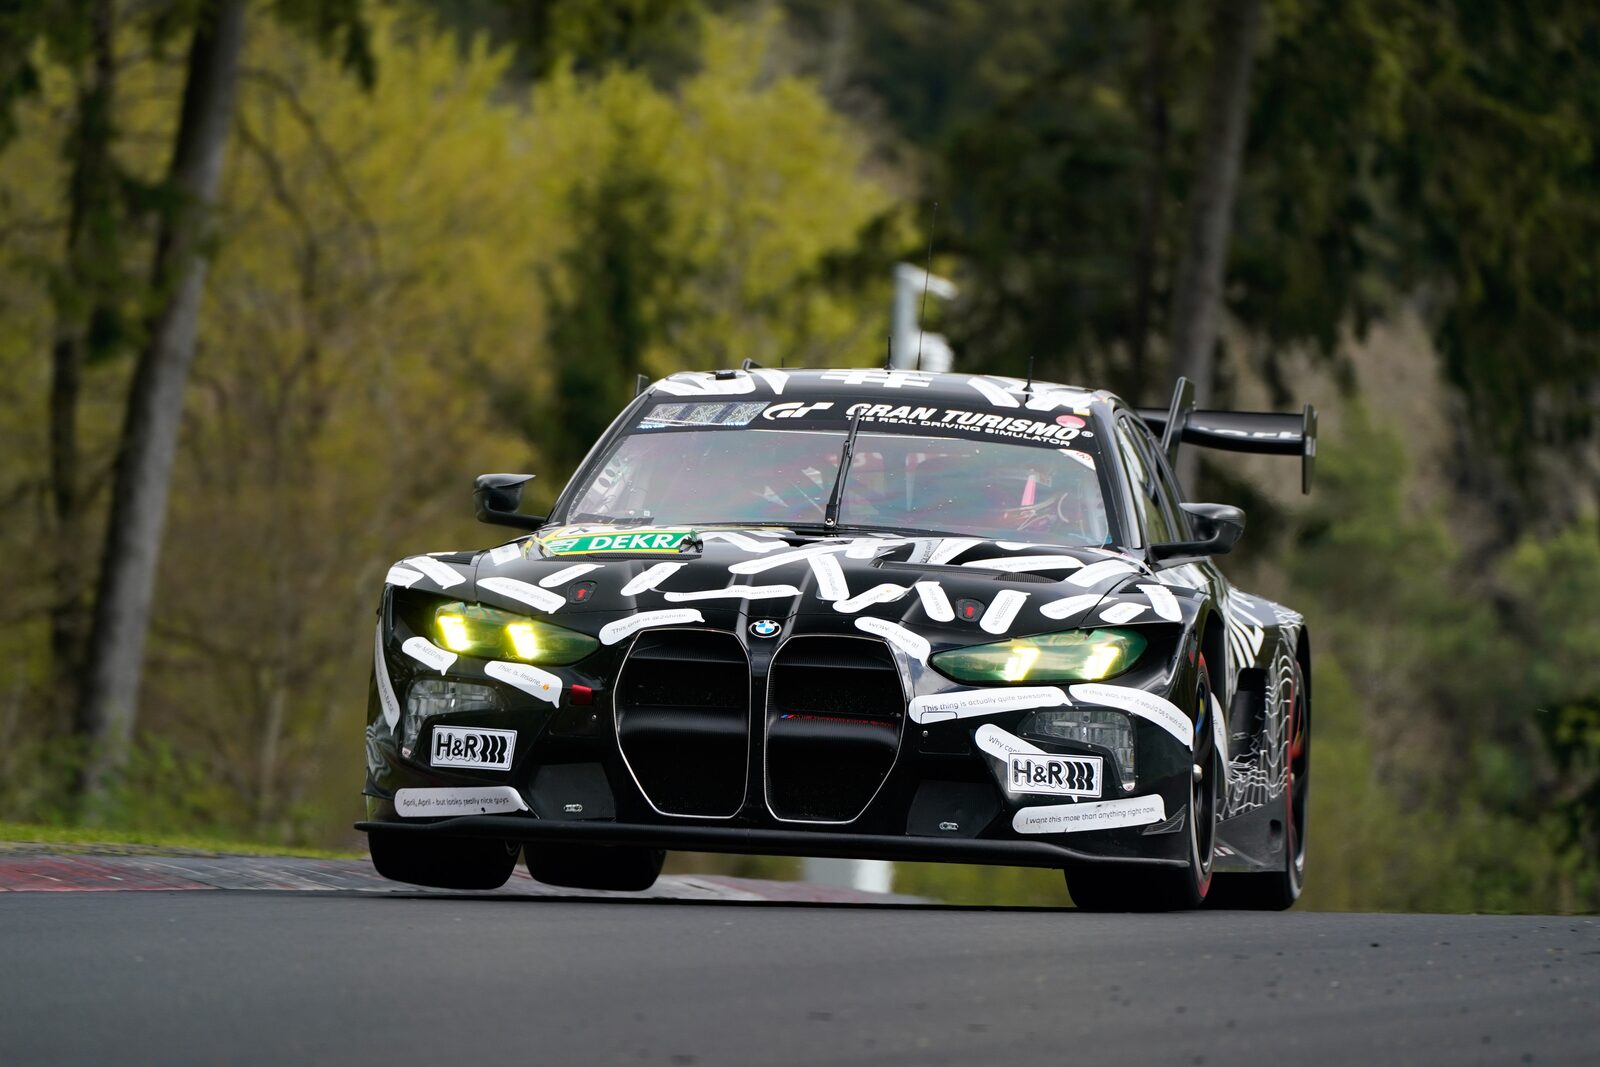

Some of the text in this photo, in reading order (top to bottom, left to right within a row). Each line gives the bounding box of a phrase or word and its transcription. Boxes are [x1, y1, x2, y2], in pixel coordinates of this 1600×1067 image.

[845, 402, 938, 421] GRAN
[880, 417, 917, 426] REAL
[920, 420, 982, 433] DRIVING
[984, 428, 1071, 447] SIMULATOR
[921, 704, 939, 713] This
[939, 702, 960, 711] thing
[968, 696, 997, 707] actually
[997, 695, 1017, 704] quite
[1016, 692, 1053, 701] awesome
[436, 732, 478, 760] H&R
[988, 735, 1005, 748] Why
[1012, 759, 1064, 787] H&R
[402, 798, 418, 808] April,
[418, 798, 432, 807] April
[436, 798, 447, 806] but
[446, 798, 463, 806] looks
[463, 797, 481, 807] really
[480, 796, 494, 804] nice
[1029, 816, 1048, 825] want
[1048, 815, 1062, 823] this
[1098, 809, 1127, 820] anything
[1127, 808, 1142, 817] right
